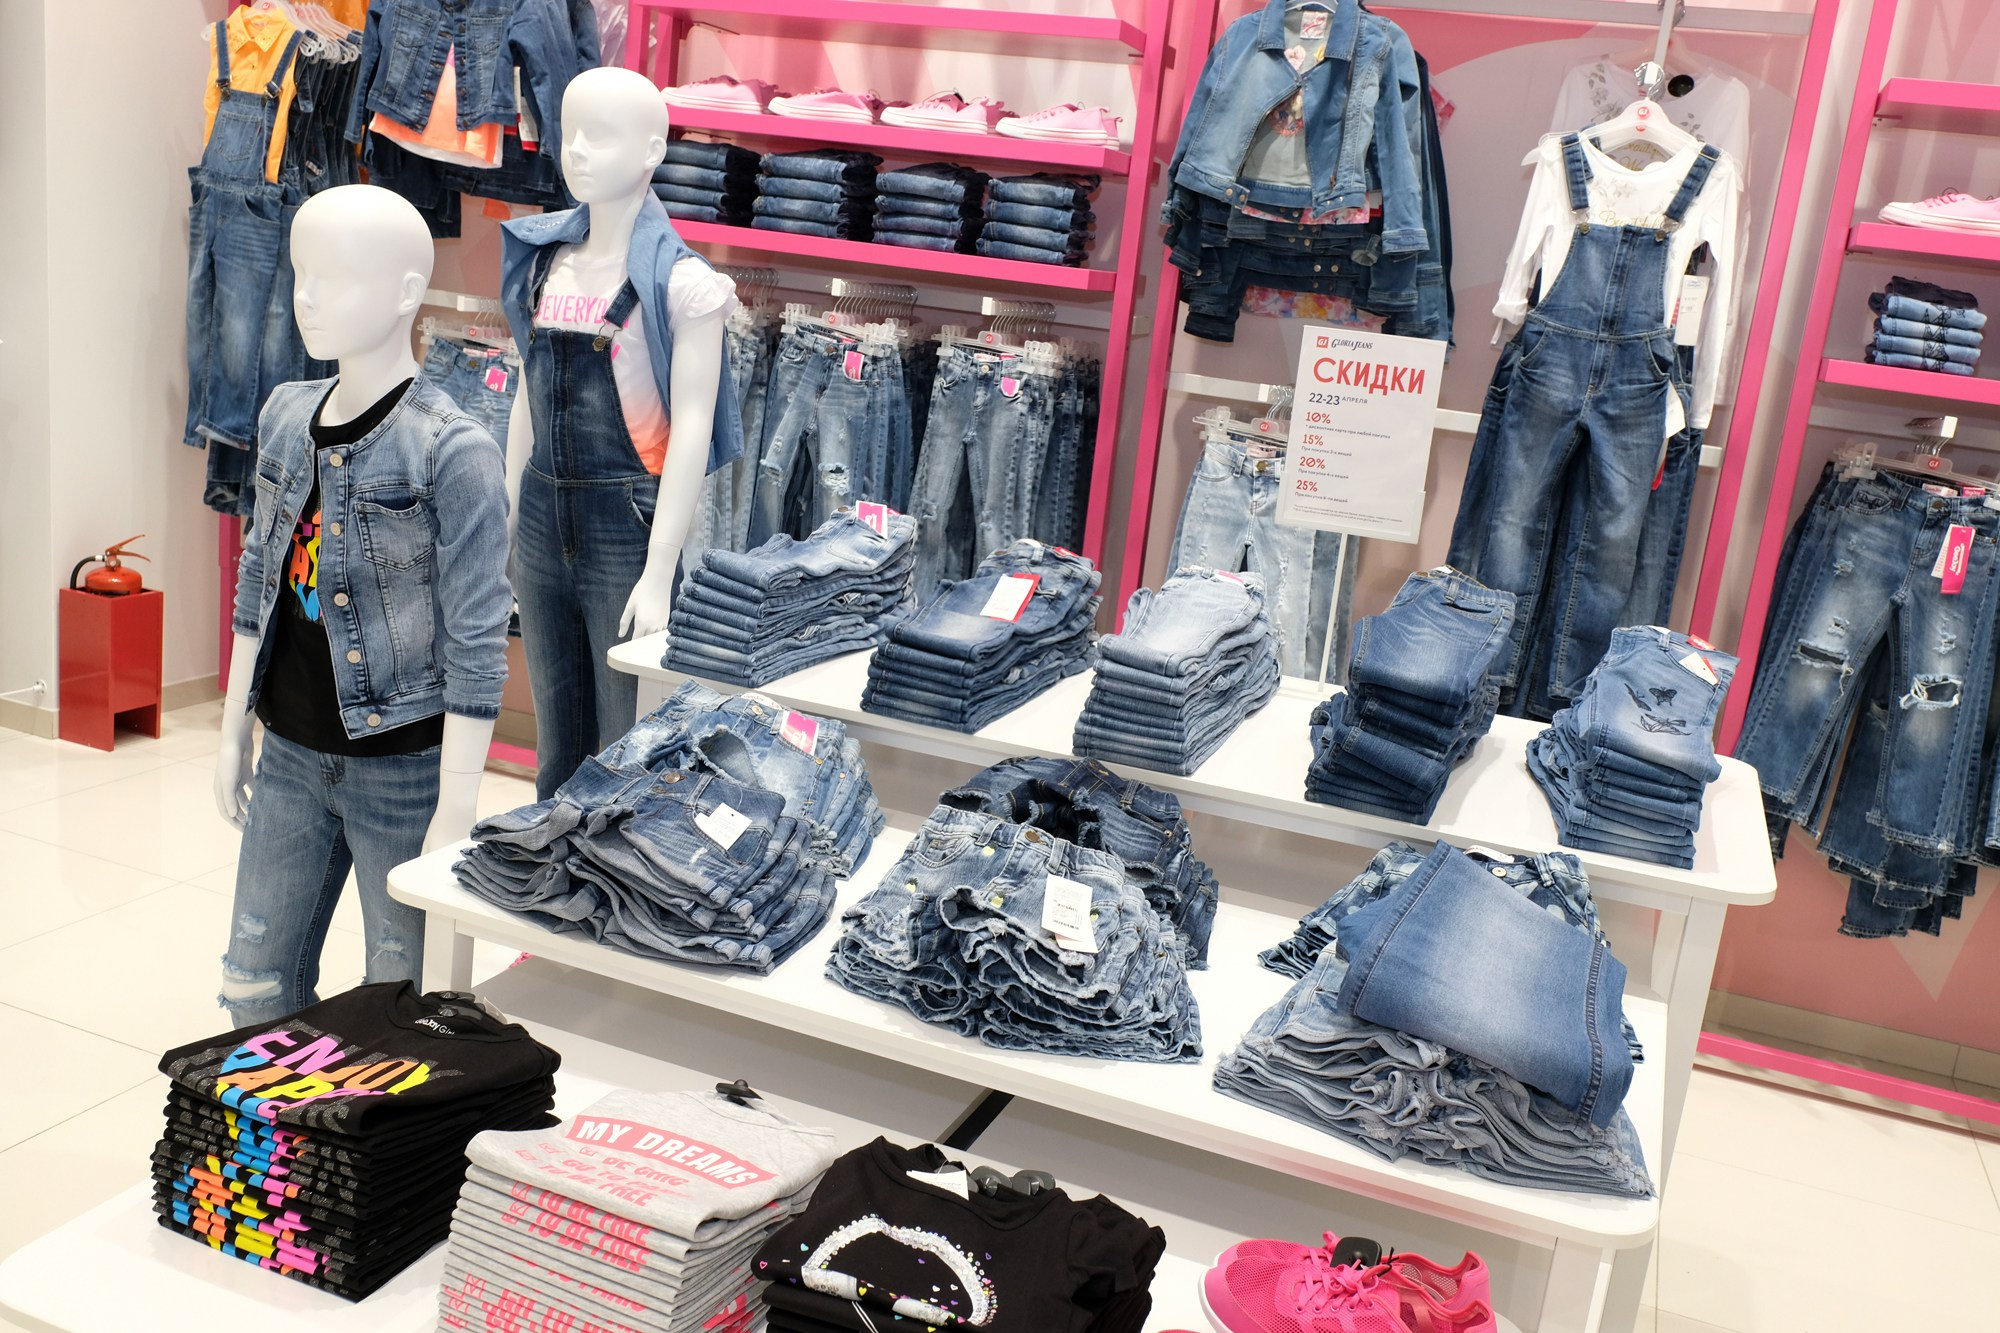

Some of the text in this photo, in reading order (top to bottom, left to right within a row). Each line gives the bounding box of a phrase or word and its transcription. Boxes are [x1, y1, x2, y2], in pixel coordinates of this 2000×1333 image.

[1313, 357, 1425, 396] СКИДКИ
[1308, 392, 1368, 405] 22-23 АПРЕЛЯ
[1305, 411, 1331, 424] 10%
[1302, 434, 1324, 446] 15%
[1299, 456, 1326, 470] 20%
[1295, 479, 1318, 492] 25%
[246, 1020, 455, 1096] ENJOY
[576, 1120, 759, 1185] MY DREAMS
